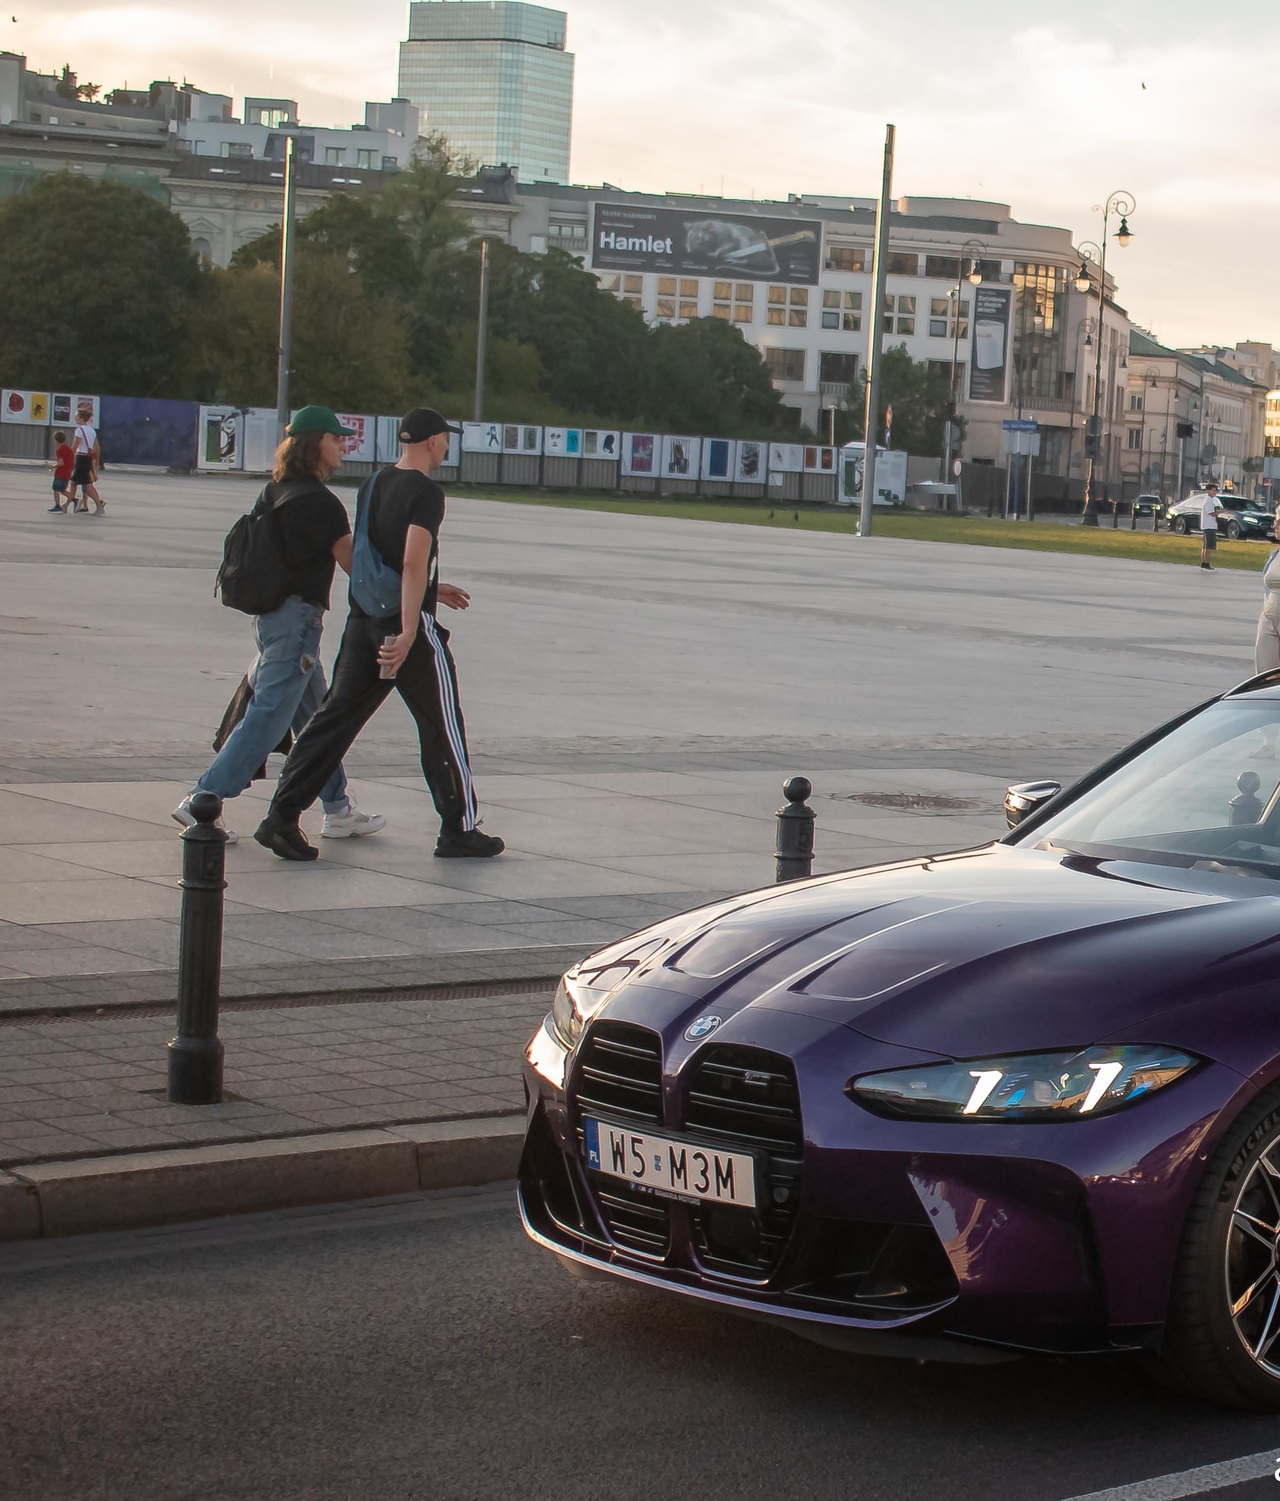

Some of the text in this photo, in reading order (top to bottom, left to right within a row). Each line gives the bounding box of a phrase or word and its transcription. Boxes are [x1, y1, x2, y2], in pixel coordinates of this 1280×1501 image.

[600, 231, 673, 254] Hamlet
[589, 1129, 737, 1200] PL W5 M3M
